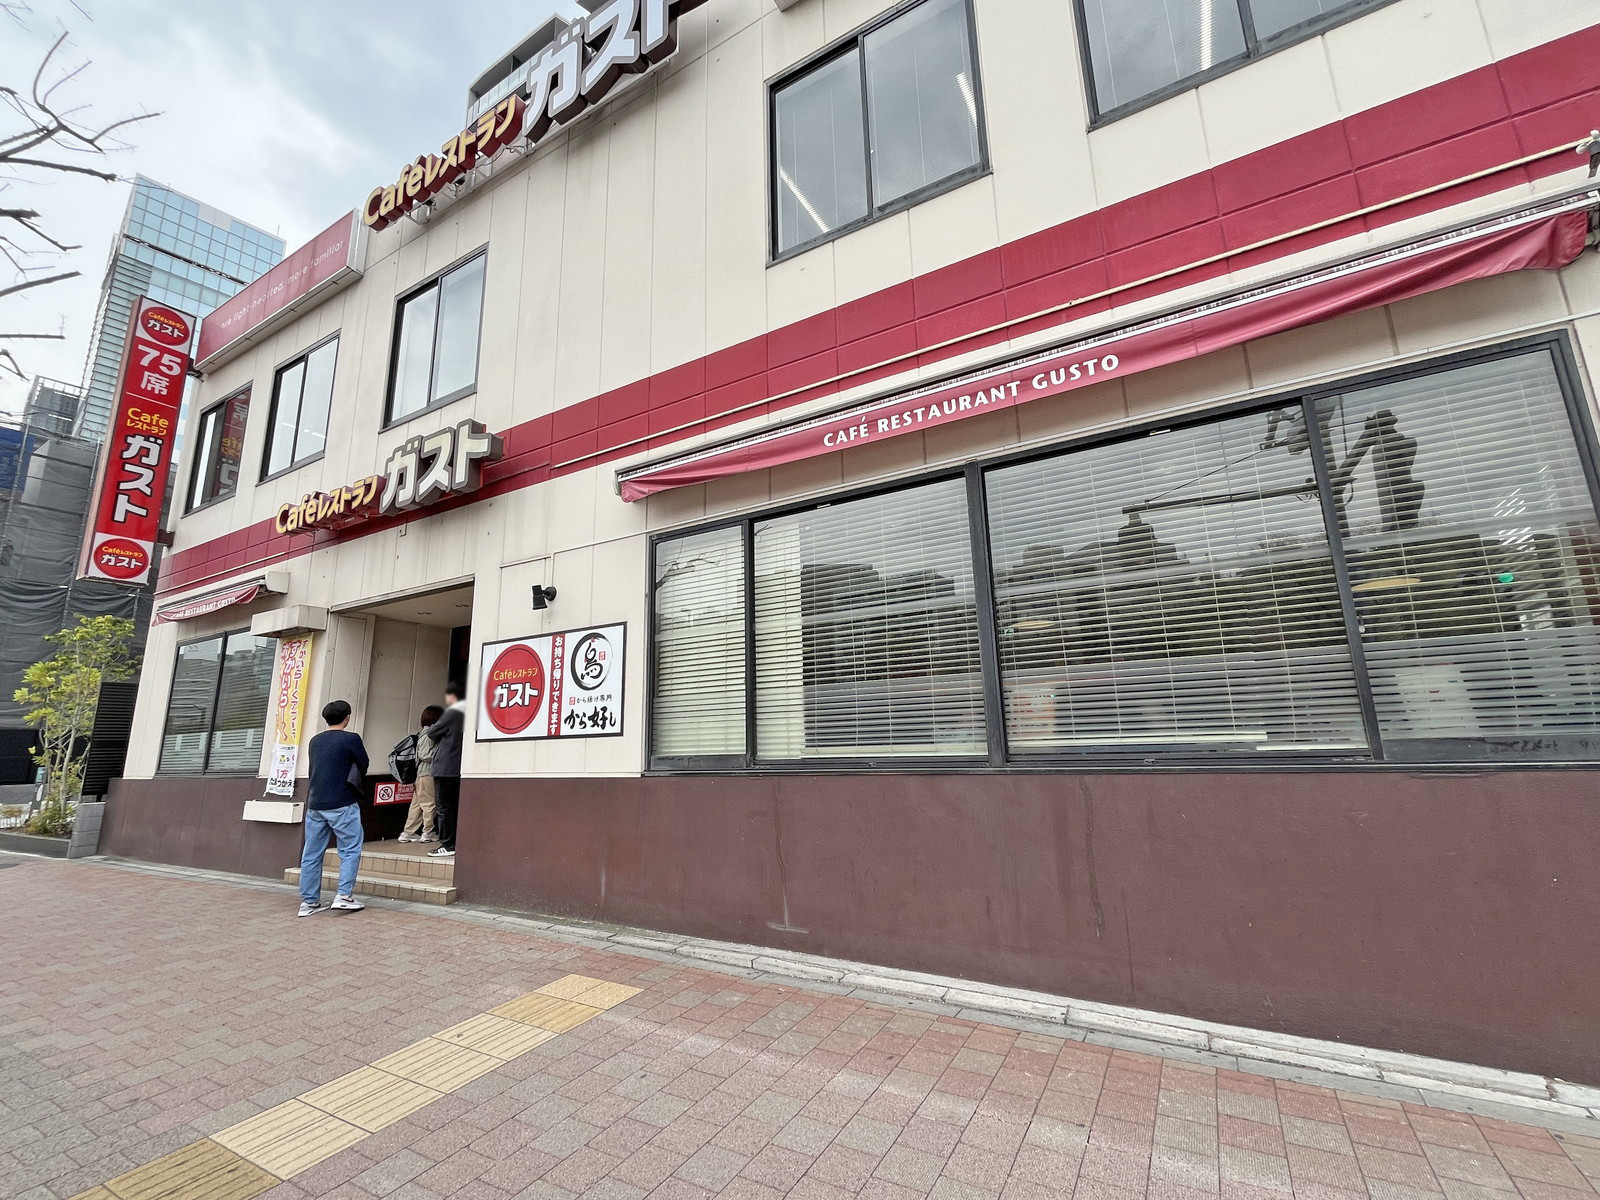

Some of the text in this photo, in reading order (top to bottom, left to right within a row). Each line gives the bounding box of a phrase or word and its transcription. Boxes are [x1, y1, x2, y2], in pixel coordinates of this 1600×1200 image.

[147, 319, 185, 338] ガスト
[138, 344, 182, 376] 75
[140, 370, 170, 396] 席
[823, 353, 1120, 448] CAFÉ RESTAURANT GUSTO
[126, 418, 167, 436] レストラン
[113, 434, 163, 523] ガスト
[275, 418, 492, 534] Caféレストラン ガスト
[100, 554, 143, 569] ガスト
[185, 602, 217, 617] RESTAURANT
[493, 667, 538, 681] Caféレストラン
[549, 636, 564, 736] お持ち帰りできます
[492, 682, 540, 709] ガスト
[564, 705, 617, 731] から好し
